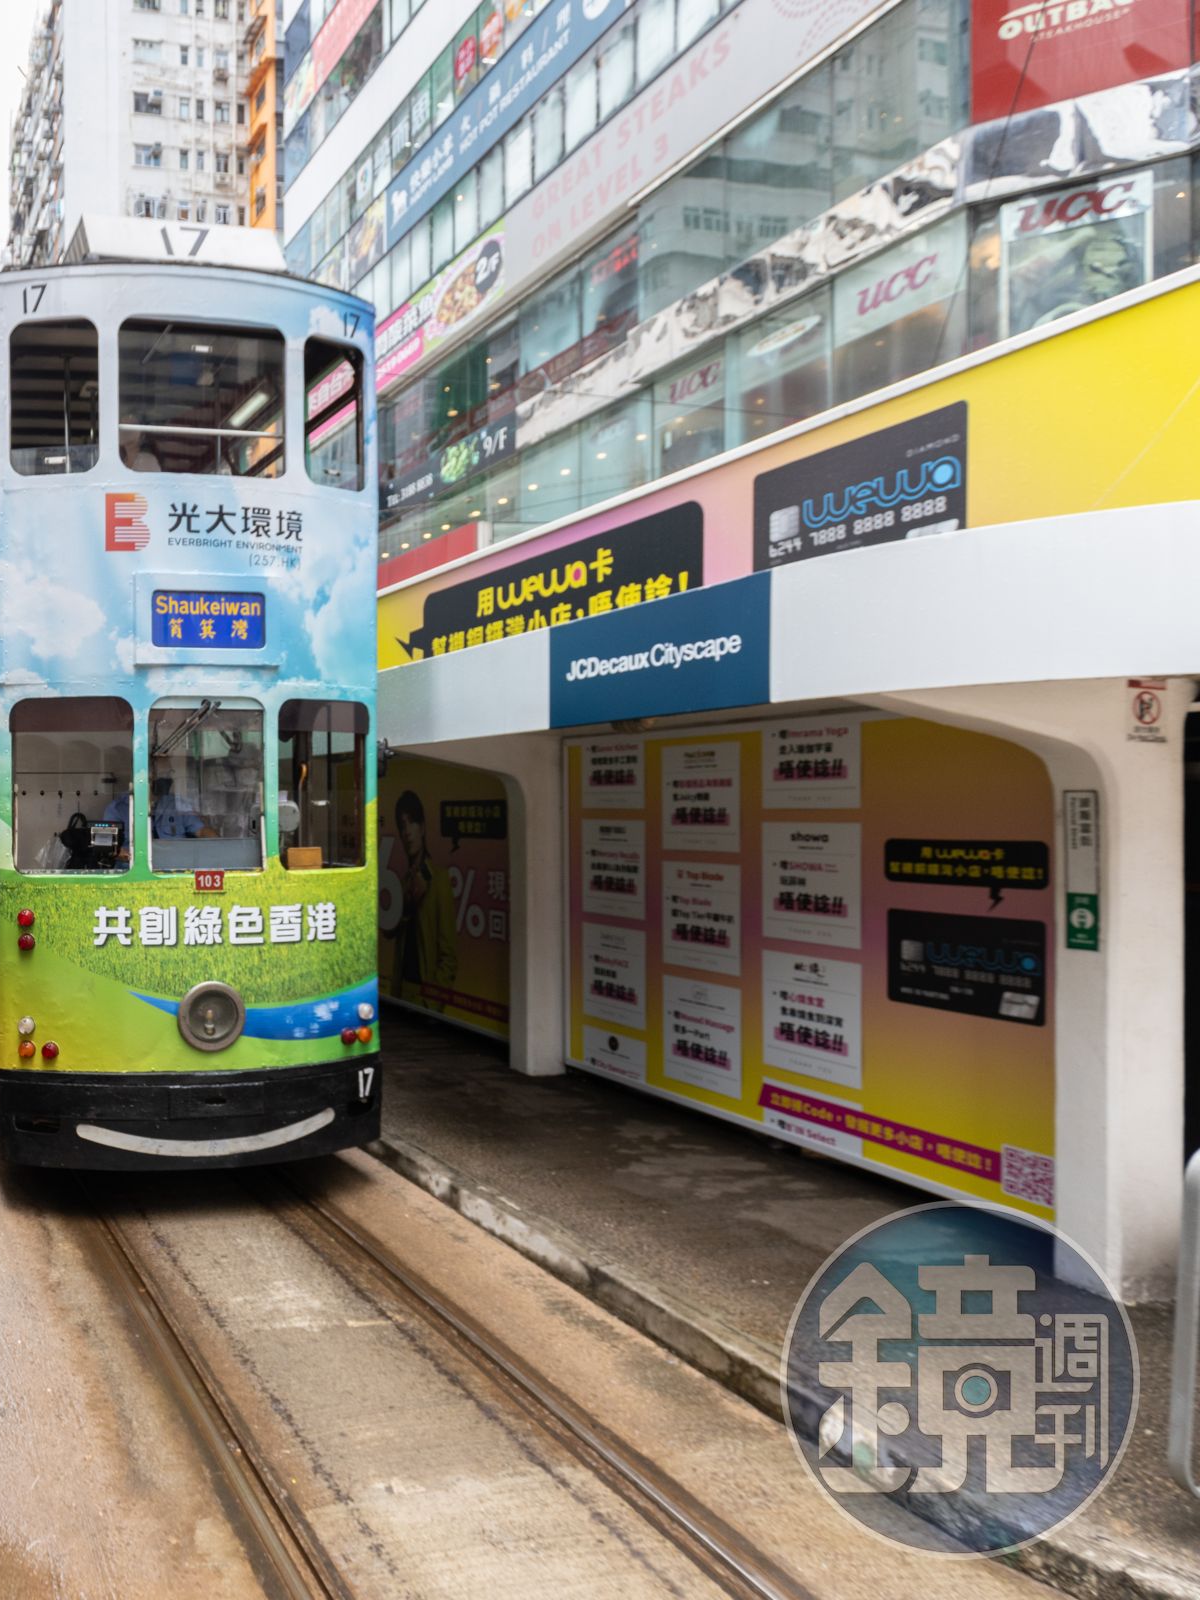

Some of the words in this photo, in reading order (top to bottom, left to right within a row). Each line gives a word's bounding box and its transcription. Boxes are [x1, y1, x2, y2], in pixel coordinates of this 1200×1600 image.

[499, 28, 571, 113] RESTAURANT
[531, 139, 603, 221] GREAT
[616, 32, 731, 149] STEAKS
[572, 158, 644, 233] LEVEL
[1015, 180, 1135, 234] UCC
[160, 226, 210, 257] 17
[22, 283, 47, 314] 17
[855, 253, 939, 317] UCC
[342, 312, 361, 338] 17
[168, 501, 304, 542] 光大環境
[853, 509, 895, 536] 8888
[901, 495, 947, 521] 8888
[167, 537, 233, 551] EVERBRIGHT
[235, 540, 303, 554] ENVIRONMENT
[155, 595, 262, 617] Shaukeiwan
[167, 618, 250, 641] 筲箕灣
[566, 649, 651, 682] JCDecaux
[650, 634, 742, 669] Cityscape
[790, 831, 830, 844] showa
[198, 873, 221, 889] 103
[92, 902, 337, 946] 共創綠色香港
[357, 1067, 375, 1099] 17
